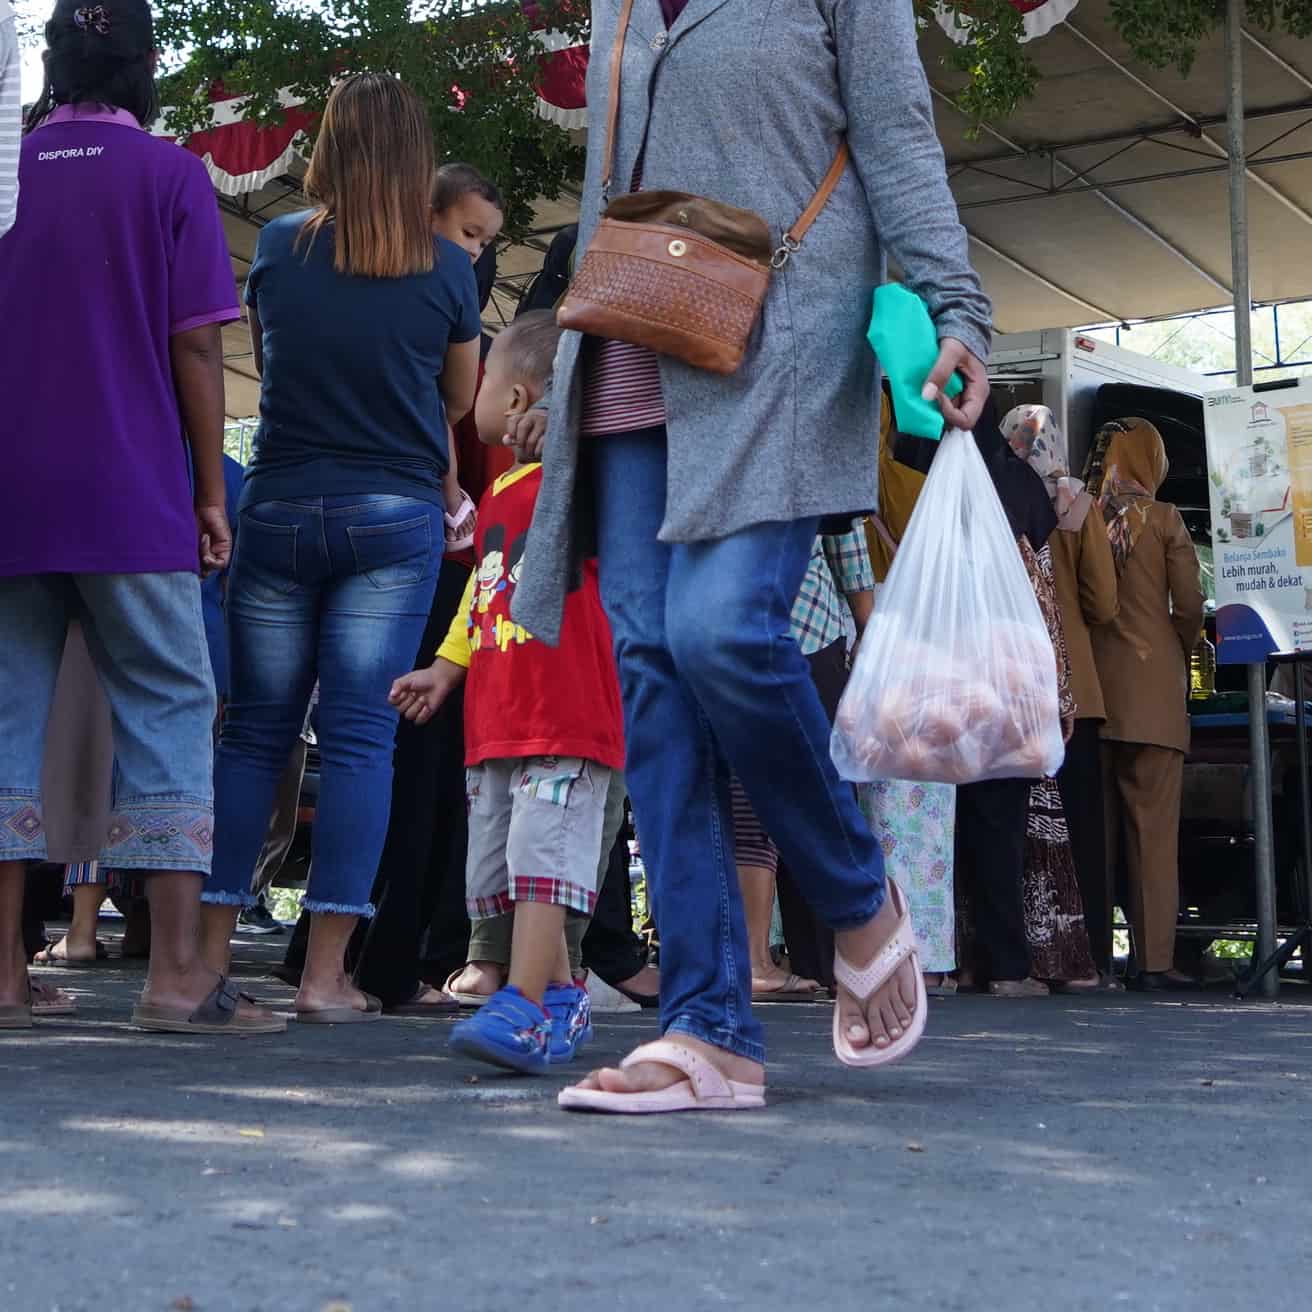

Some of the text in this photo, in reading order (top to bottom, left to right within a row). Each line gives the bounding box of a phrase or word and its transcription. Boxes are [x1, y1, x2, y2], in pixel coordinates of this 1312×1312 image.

[38, 146, 104, 160] DISPORA DIY
[1222, 562, 1279, 578] Lebih murah,
[1236, 575, 1304, 592] mudah & dekat
